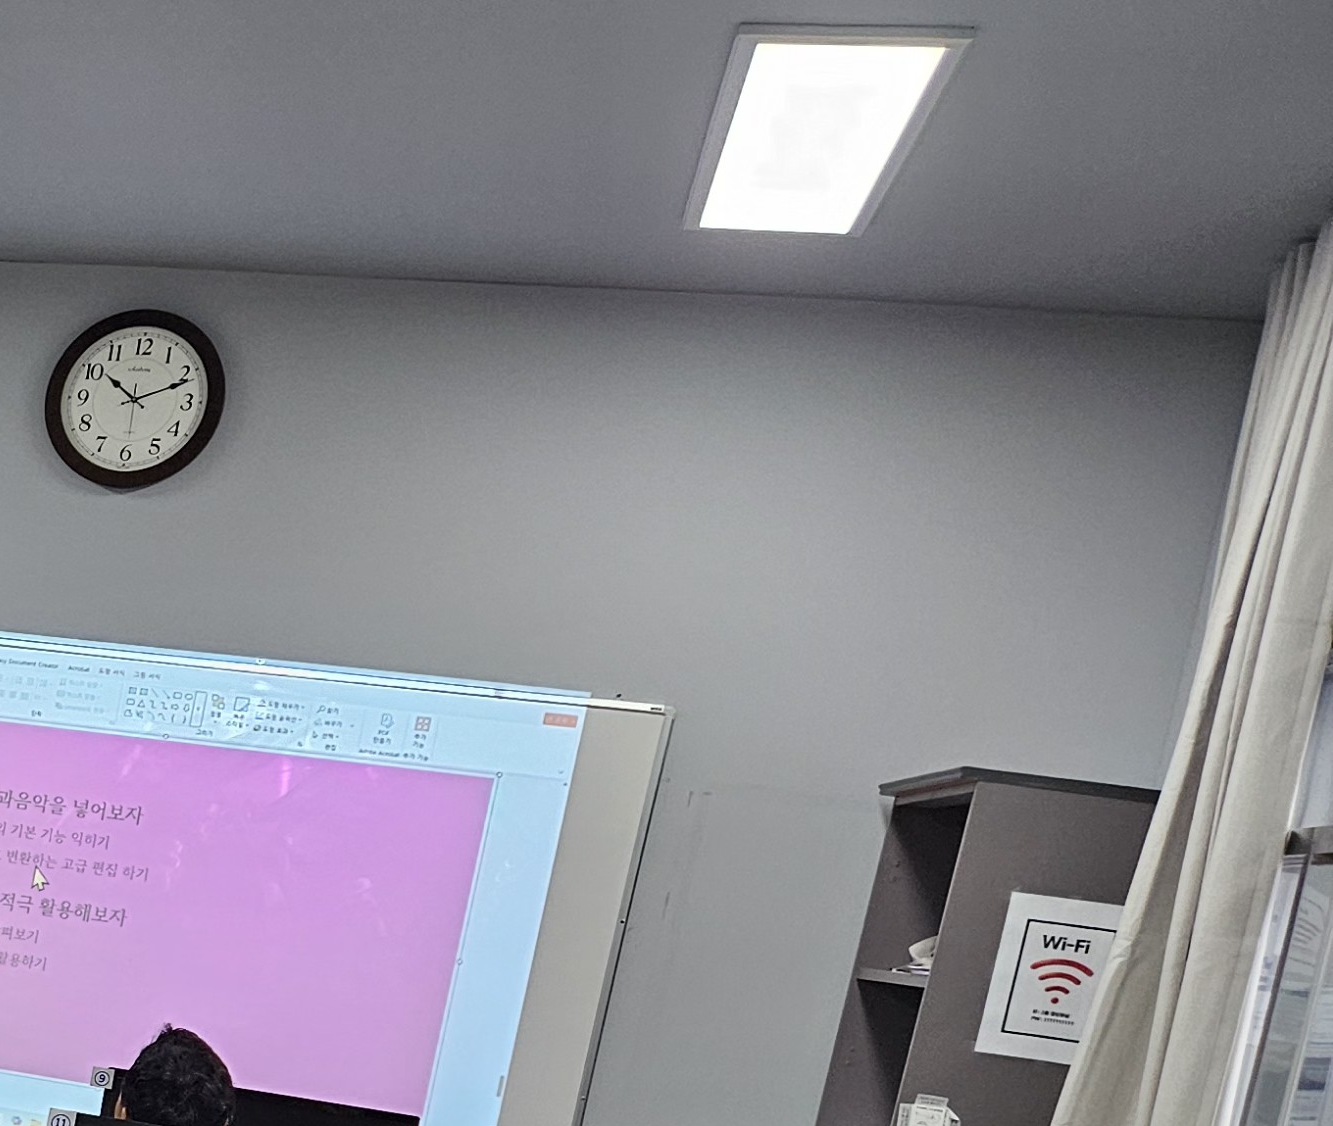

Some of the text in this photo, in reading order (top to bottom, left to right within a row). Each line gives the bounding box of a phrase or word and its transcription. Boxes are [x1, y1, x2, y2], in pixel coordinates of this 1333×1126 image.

[107, 344, 172, 364] 11 1
[135, 338, 154, 356] 12
[85, 363, 104, 380] 10
[178, 365, 191, 383] 2
[77, 389, 194, 411] 9 3
[78, 413, 180, 437] 8 4
[95, 435, 161, 461] 7 6 5
[73, 799, 144, 826] 넣어보자
[10, 823, 37, 840] 기본
[40, 827, 67, 844] 기능
[71, 831, 110, 850] 익히기
[6, 849, 58, 870] 변환하는
[61, 857, 87, 873] 고급
[92, 860, 119, 878] 편집
[122, 864, 149, 882] 하기
[0, 891, 34, 914] 적극
[39, 897, 128, 927] 활용해보자
[1042, 933, 1091, 955] Wi-Fi
